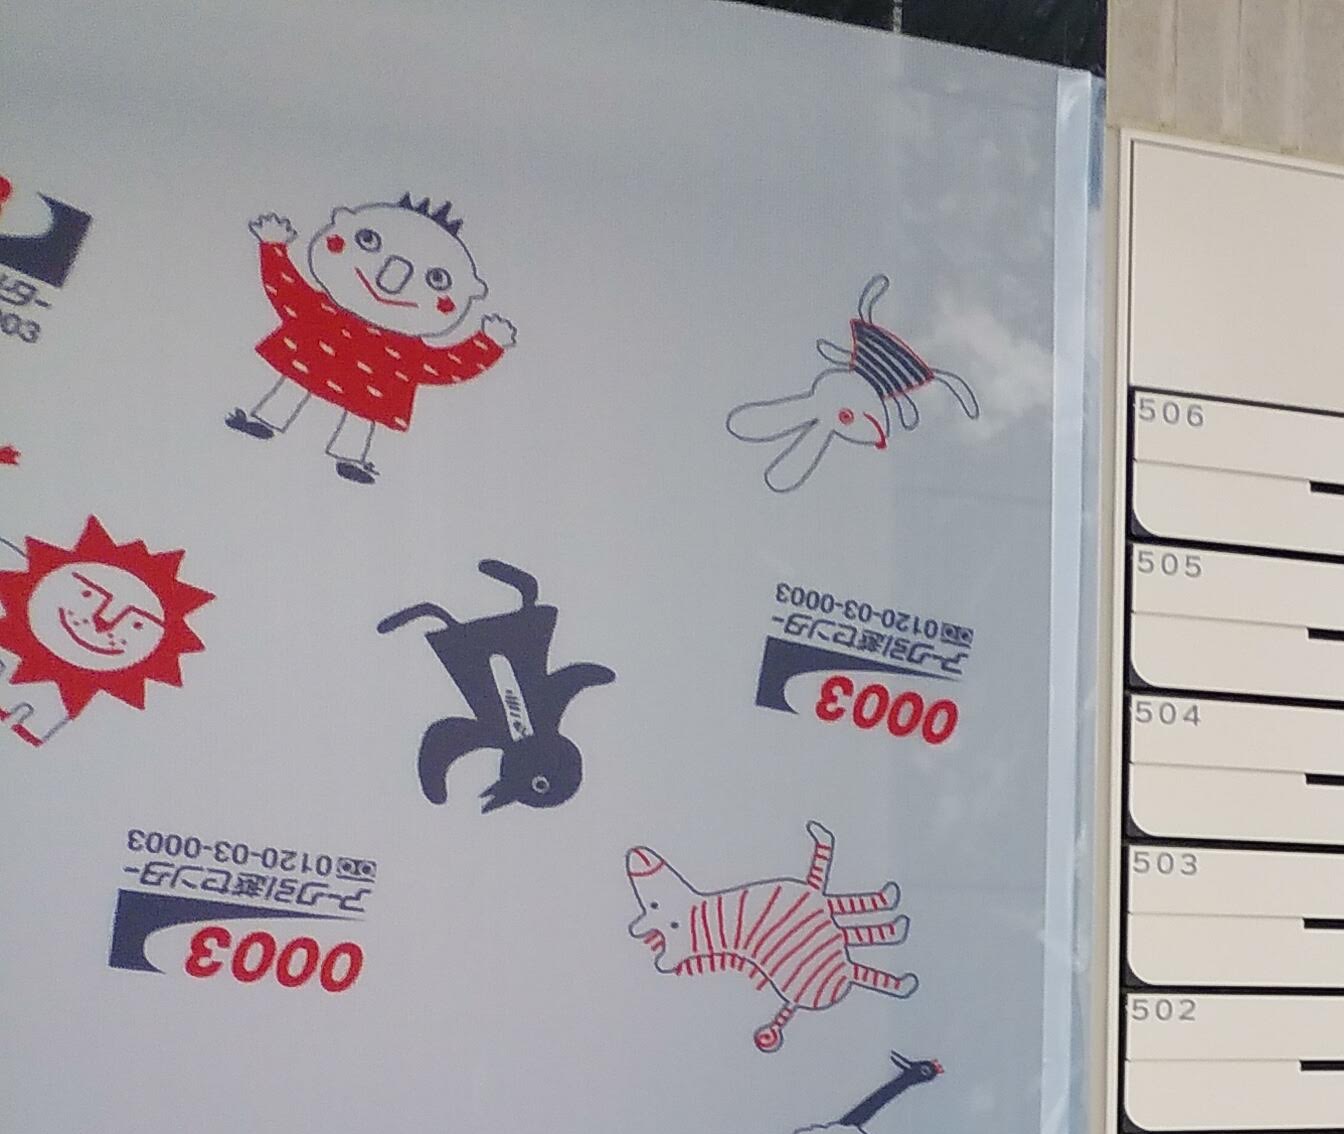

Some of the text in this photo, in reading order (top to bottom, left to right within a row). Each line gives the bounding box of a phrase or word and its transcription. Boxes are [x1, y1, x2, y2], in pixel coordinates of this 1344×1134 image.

[1139, 399, 1204, 426] 506
[1138, 551, 1202, 577] 505
[775, 582, 939, 639] 0120-03-0003
[815, 675, 959, 745] 0003
[1135, 701, 1201, 726] 504
[127, 829, 332, 877] 0120-03-0003
[1133, 851, 1197, 875] 503
[184, 926, 364, 992] 0003
[1131, 999, 1196, 1021] 502
